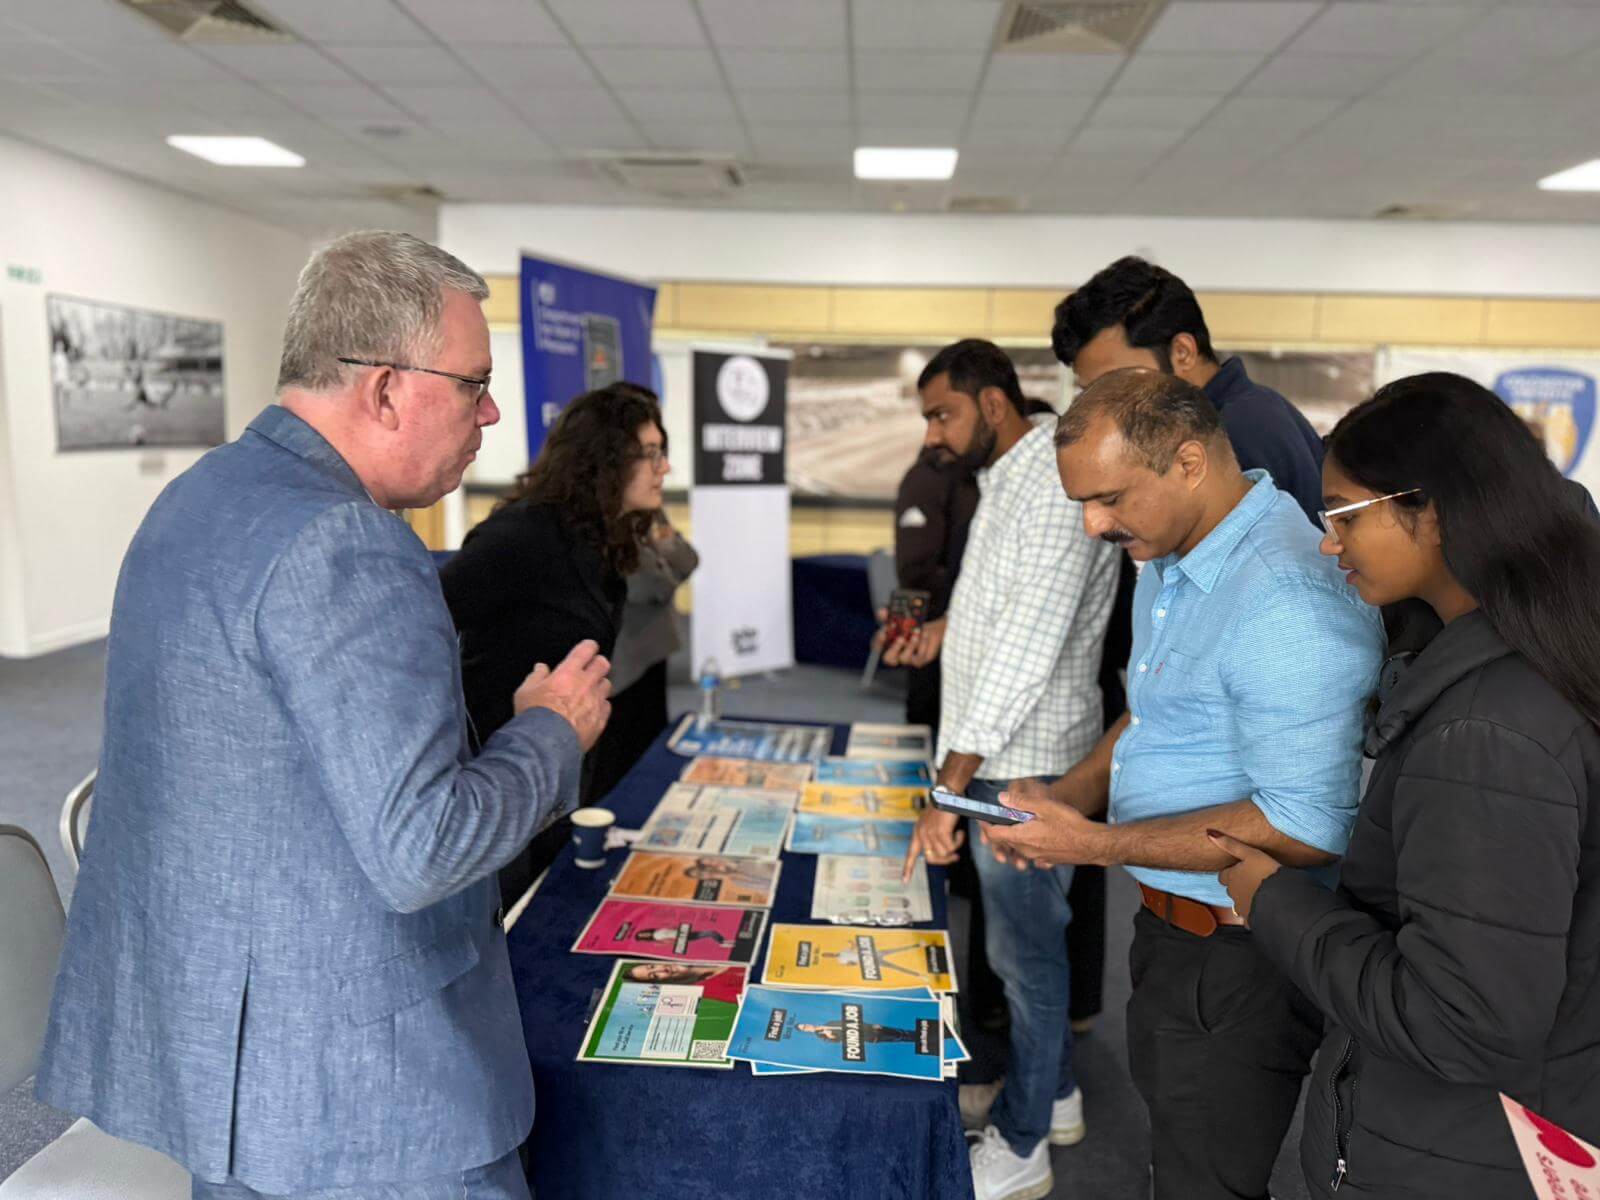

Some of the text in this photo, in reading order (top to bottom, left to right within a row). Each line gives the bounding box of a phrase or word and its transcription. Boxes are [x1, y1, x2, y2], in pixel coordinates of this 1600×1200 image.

[845, 1005, 861, 1060] FOUND A JOB
